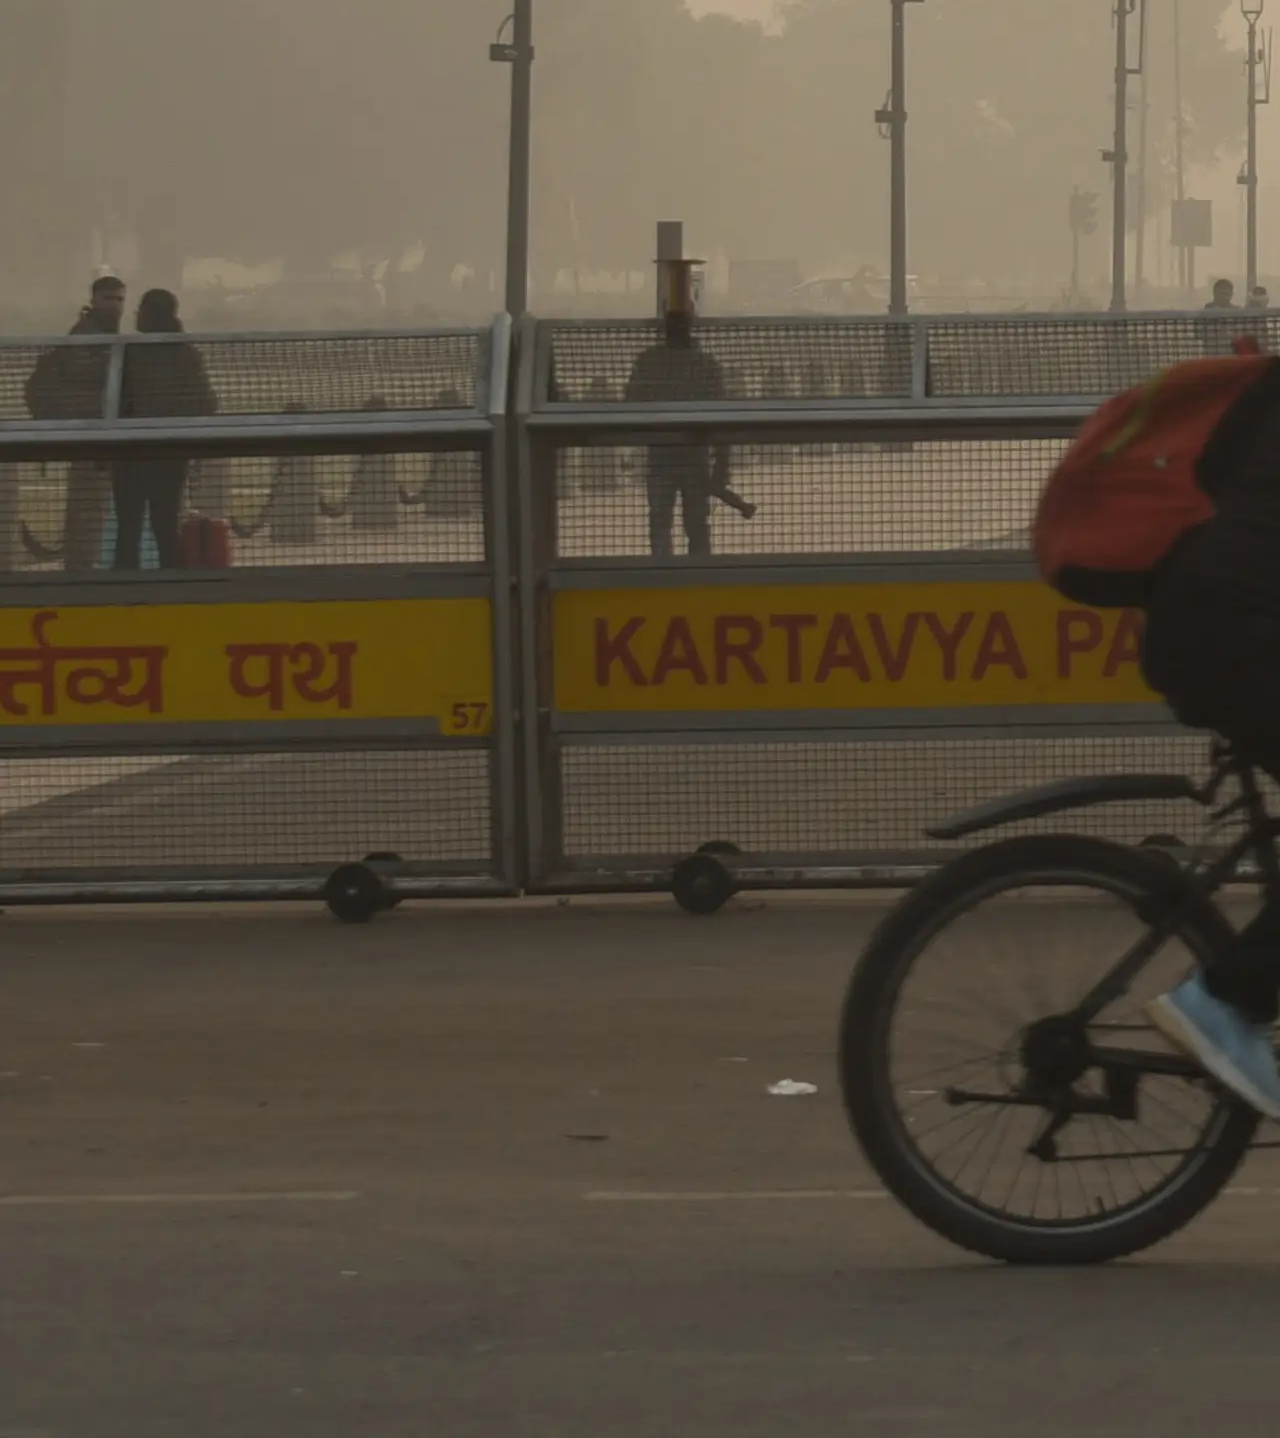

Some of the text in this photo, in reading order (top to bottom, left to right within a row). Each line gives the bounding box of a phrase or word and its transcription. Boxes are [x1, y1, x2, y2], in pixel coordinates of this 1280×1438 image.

[225, 640, 359, 711] पथ
[593, 608, 1146, 687] KARTAVYA PA
[452, 702, 488, 731] 57
